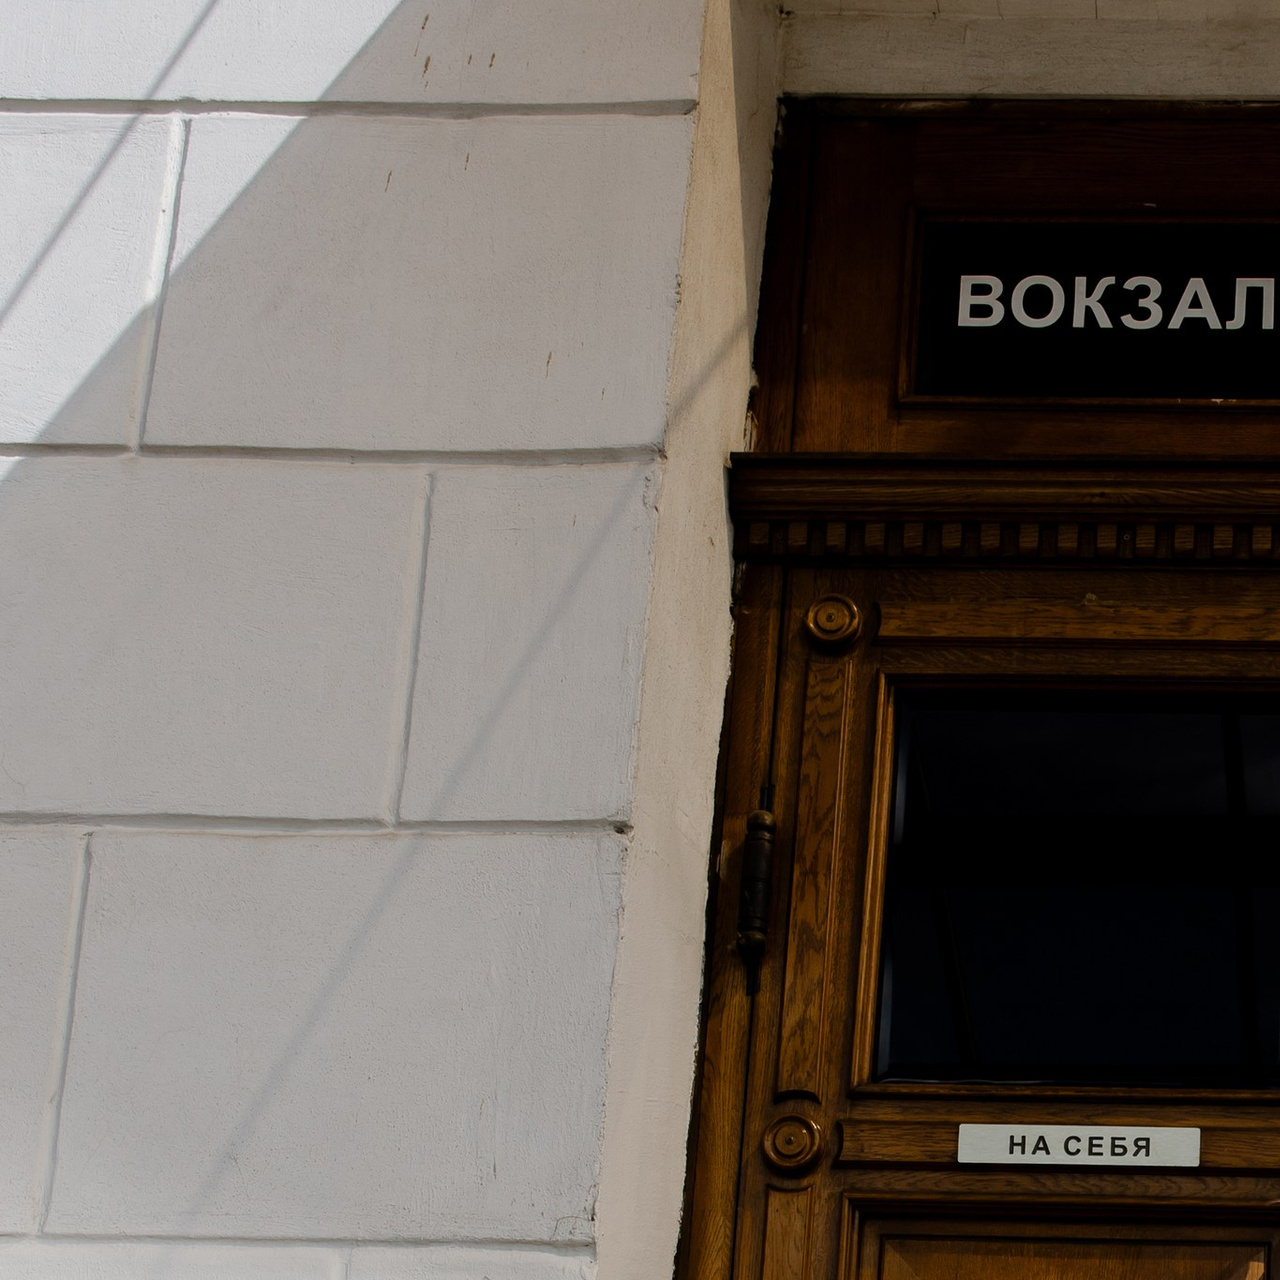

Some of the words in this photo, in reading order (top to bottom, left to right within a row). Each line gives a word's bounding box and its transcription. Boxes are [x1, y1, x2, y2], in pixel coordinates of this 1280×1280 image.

[956, 275, 1275, 330] ВОКЗАЛ
[1008, 1133, 1052, 1156] НА
[1063, 1135, 1151, 1158] СЕБЯ
